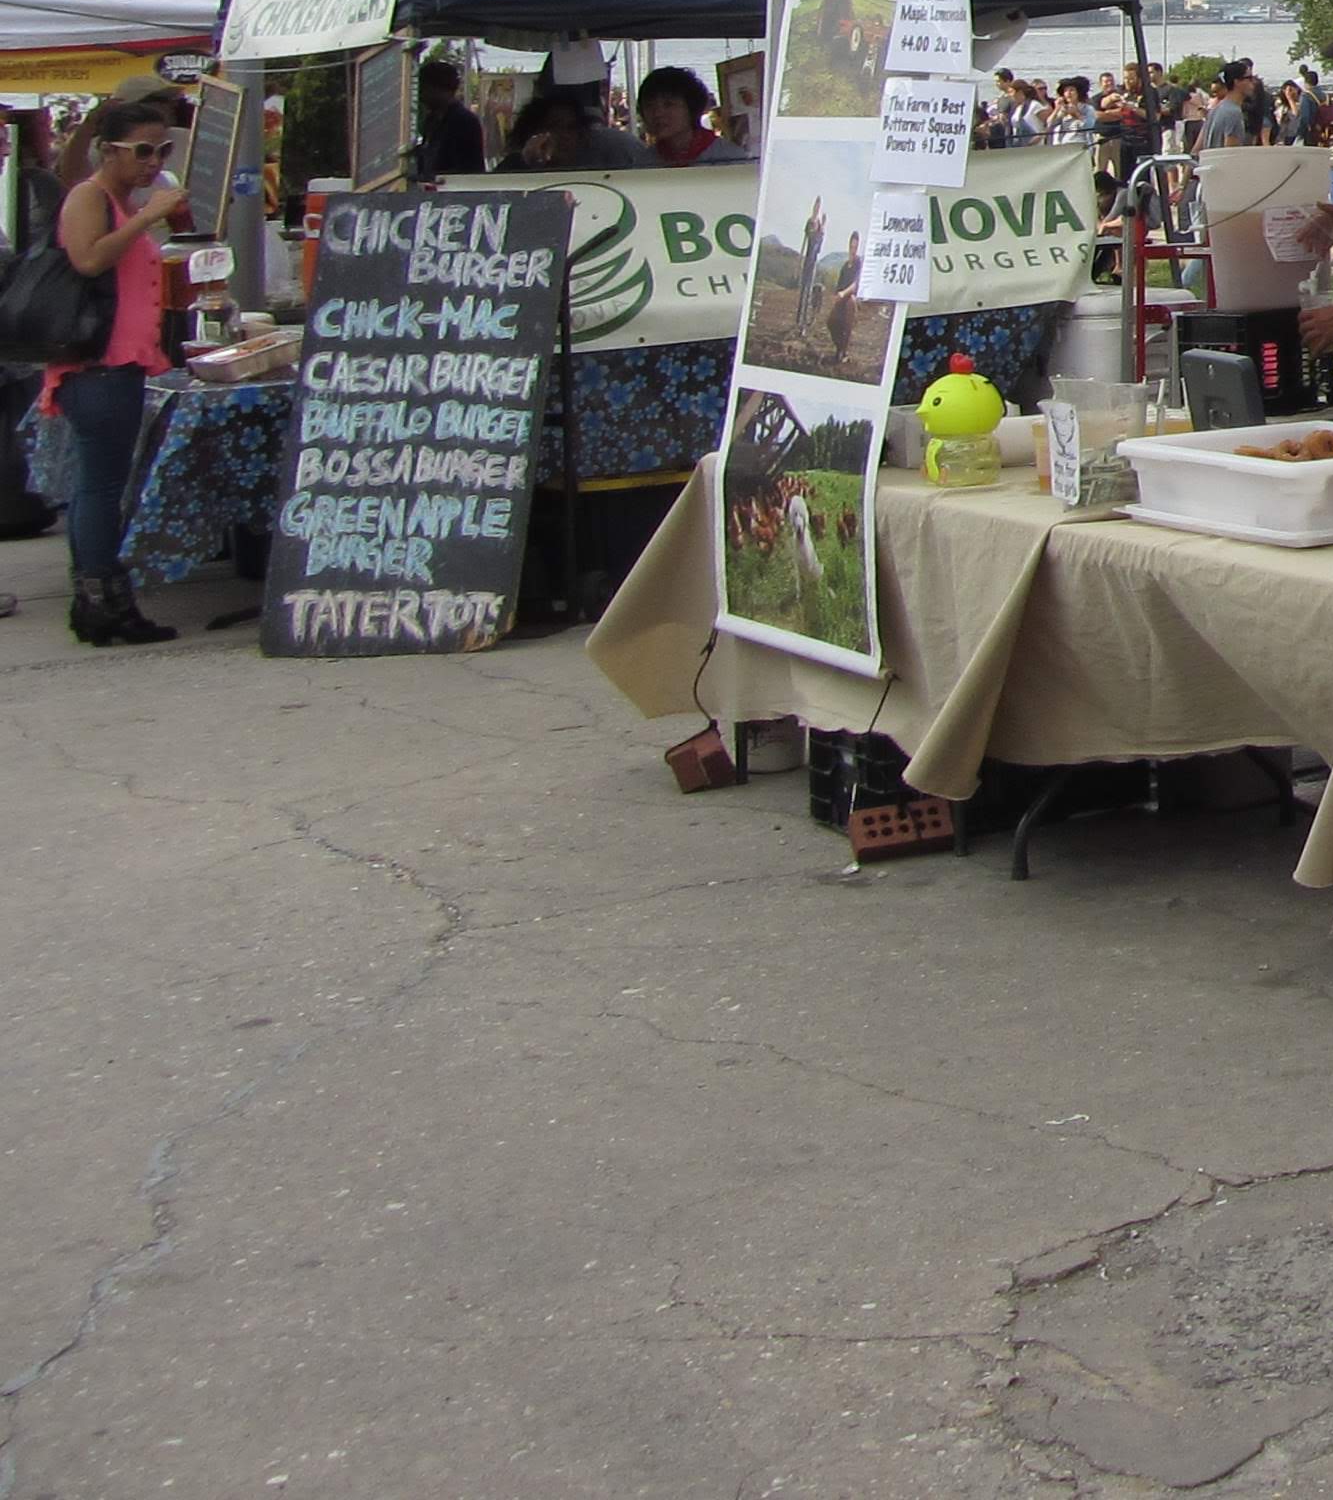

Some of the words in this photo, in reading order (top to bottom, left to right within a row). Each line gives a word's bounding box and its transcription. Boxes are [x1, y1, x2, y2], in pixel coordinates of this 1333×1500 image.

[927, 117, 967, 137] Squash
[941, 98, 966, 116] Best
[920, 137, 956, 155] $1.50
[325, 202, 512, 255] CHICKEN
[407, 248, 553, 289] BURGER
[883, 263, 915, 285] $5.00
[314, 296, 520, 342] CHICK-MAC
[305, 351, 429, 398] CAESAR
[302, 400, 433, 445] BUFFALO
[297, 444, 412, 491] BOSSA
[414, 446, 530, 490] BURGER
[280, 492, 406, 540] GREEN
[408, 496, 512, 540] APPLE
[307, 537, 433, 585] BURGER
[283, 590, 424, 643] TATER
[423, 593, 504, 642] TOTS
